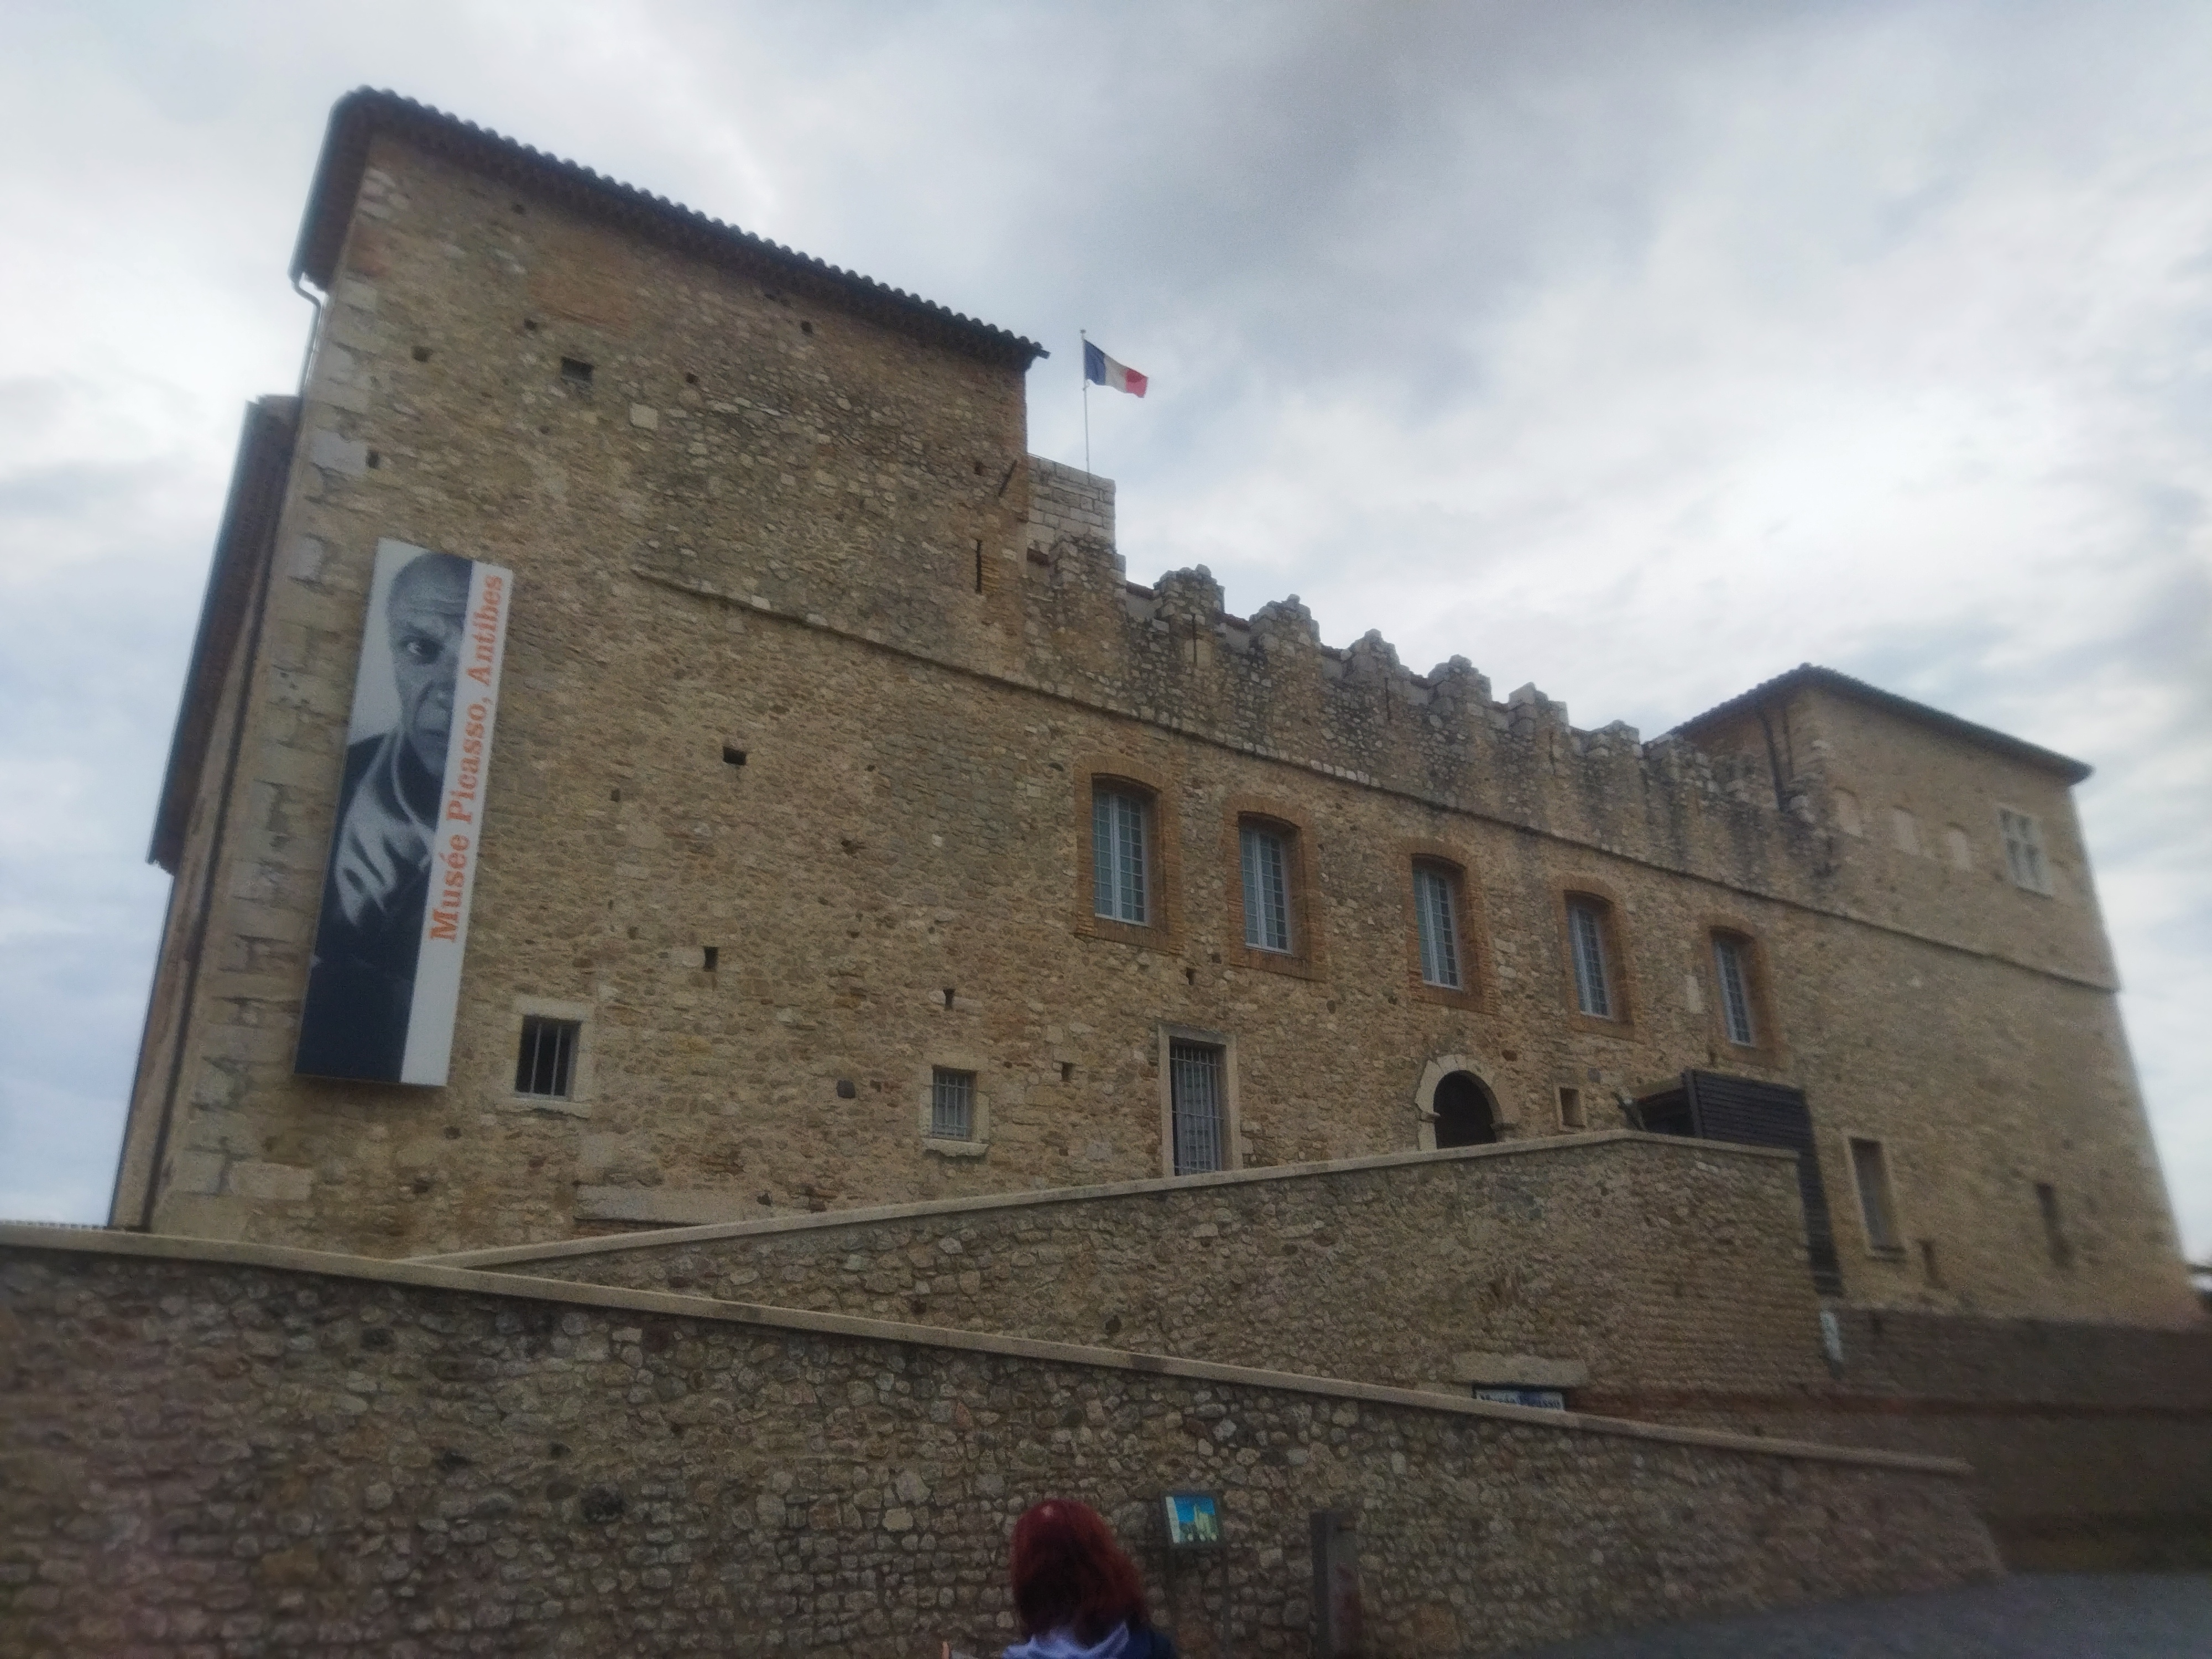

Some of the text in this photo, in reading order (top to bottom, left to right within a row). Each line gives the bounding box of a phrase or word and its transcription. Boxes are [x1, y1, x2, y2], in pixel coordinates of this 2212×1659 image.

[430, 574, 503, 942] Musée Picasso, Antibes
